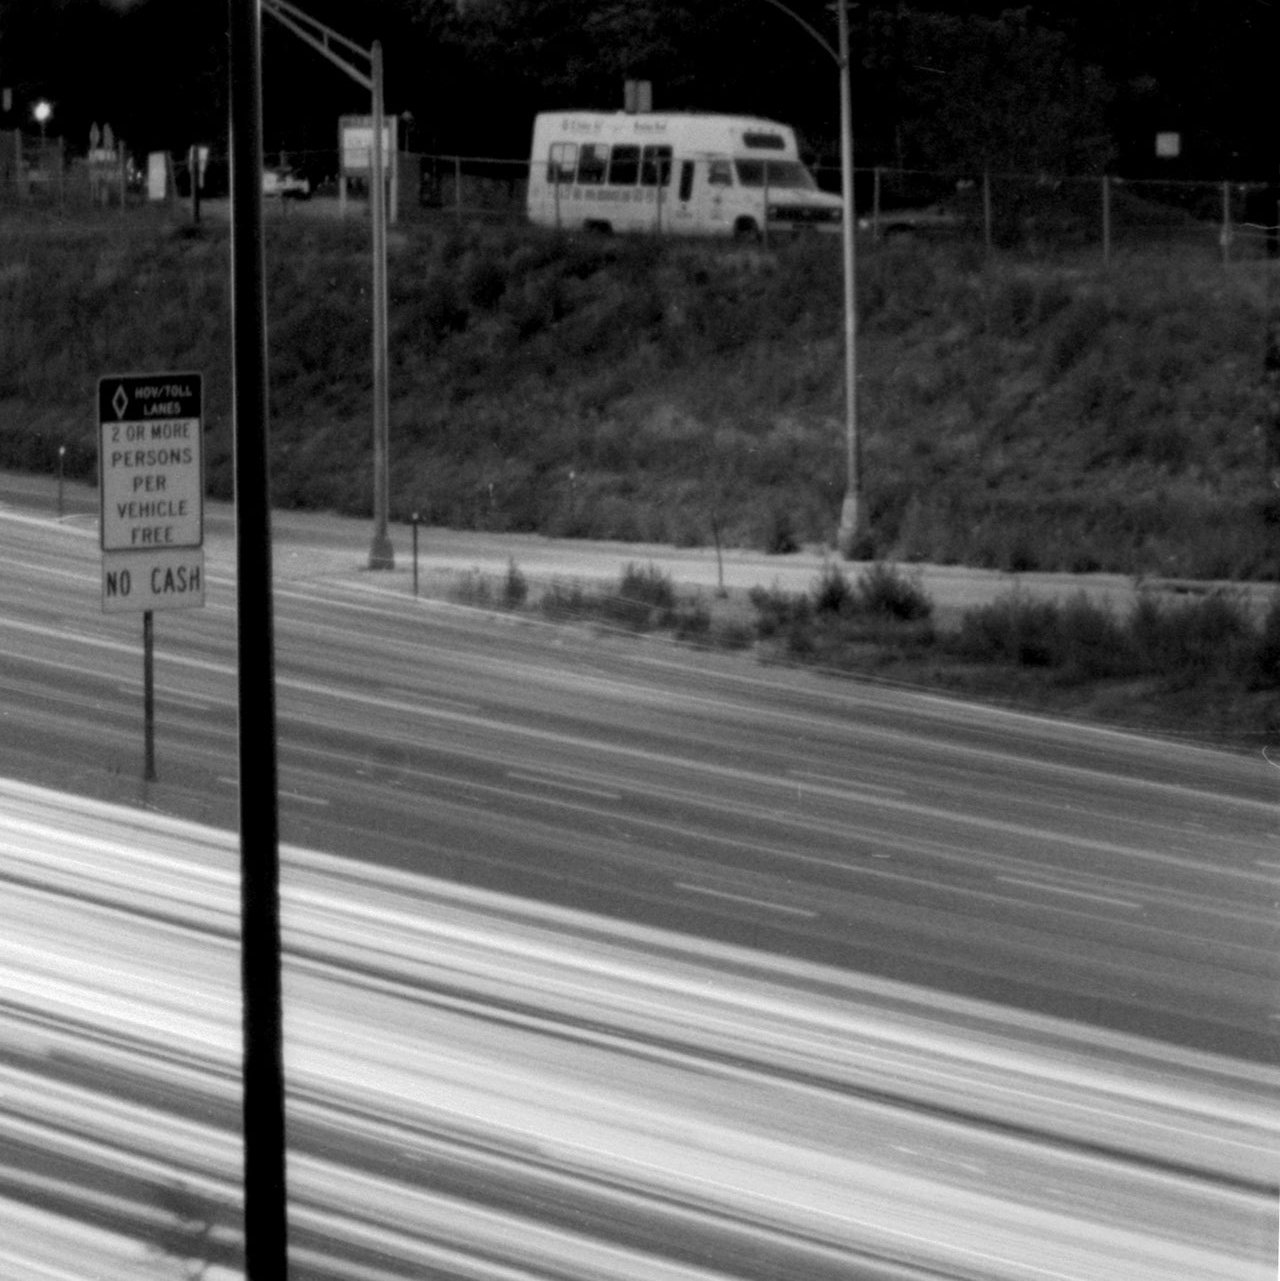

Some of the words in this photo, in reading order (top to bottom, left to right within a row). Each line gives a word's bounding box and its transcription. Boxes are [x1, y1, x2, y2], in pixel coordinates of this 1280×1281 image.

[134, 384, 193, 399] HOV/TOLL
[143, 401, 182, 416] LANES
[111, 426, 120, 443] 2
[126, 425, 145, 441] OR
[151, 423, 190, 440] MORE
[111, 448, 193, 468] PERSONS
[133, 474, 167, 493] PER
[117, 499, 188, 519] VEHICLE
[131, 526, 174, 545] FREE
[106, 569, 132, 598] NO
[150, 565, 201, 595] CASH
